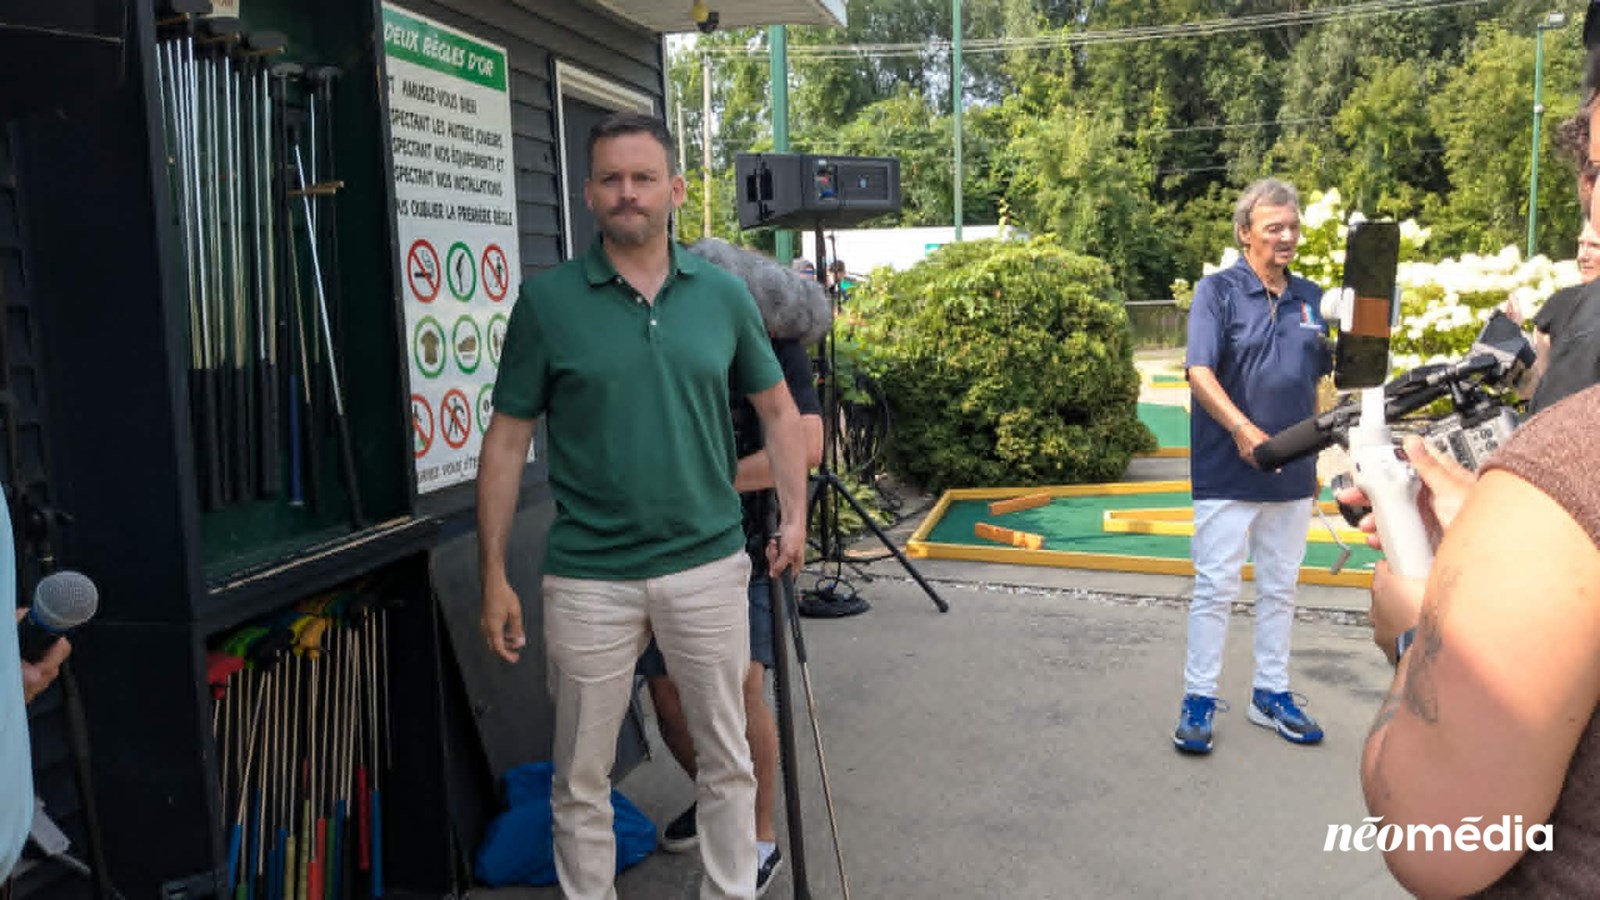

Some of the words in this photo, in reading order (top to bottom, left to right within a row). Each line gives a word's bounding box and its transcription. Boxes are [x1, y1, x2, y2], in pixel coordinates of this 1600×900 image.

[384, 22, 419, 52] DEUX
[468, 52, 494, 78] D'OR
[433, 118, 445, 137] LES
[448, 121, 474, 143] AUTRES
[434, 145, 450, 163] NOS
[496, 157, 504, 172] ET
[453, 174, 502, 197] INSTALLATIONS
[411, 200, 444, 219] OUBLIER
[446, 205, 456, 220] LA
